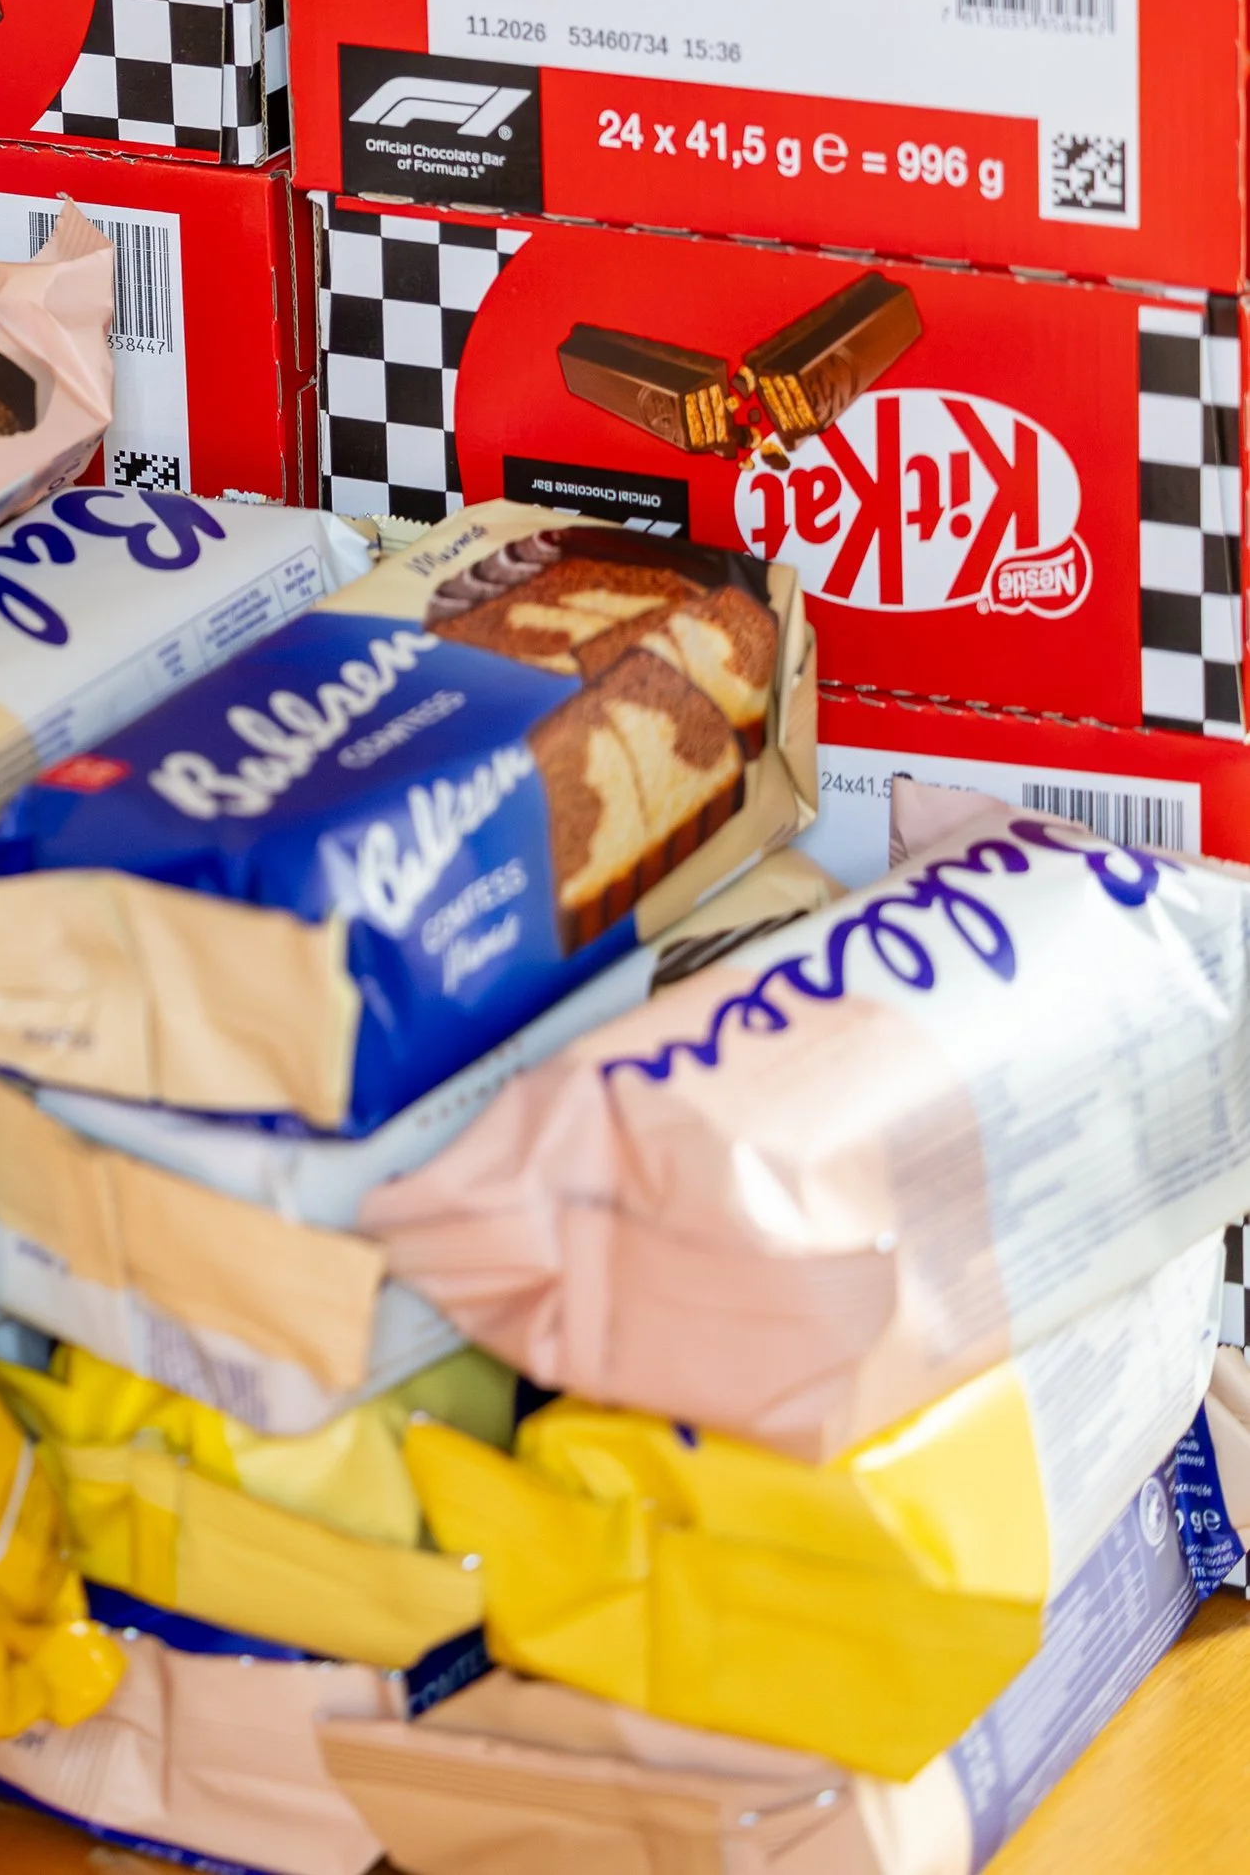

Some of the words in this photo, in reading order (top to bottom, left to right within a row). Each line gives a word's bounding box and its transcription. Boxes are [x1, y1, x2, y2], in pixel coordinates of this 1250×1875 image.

[466, 15, 547, 42] 11.2026
[568, 26, 669, 55] 53460734
[684, 38, 742, 63] 15:36
[365, 138, 411, 155] Official
[413, 143, 481, 163] Chocolate
[482, 152, 506, 167] Bar
[597, 110, 644, 150] 24
[654, 124, 676, 155] x
[686, 119, 766, 169] 41,5
[776, 136, 801, 177] g
[862, 150, 887, 174] =
[897, 142, 968, 187] 996
[978, 157, 1004, 200] g
[397, 158, 411, 171] of
[413, 160, 469, 177] Formula
[531, 478, 554, 493] Bar
[556, 481, 617, 503] Chocolate
[619, 490, 661, 508] Official
[150, 633, 439, 818] Bahlsen
